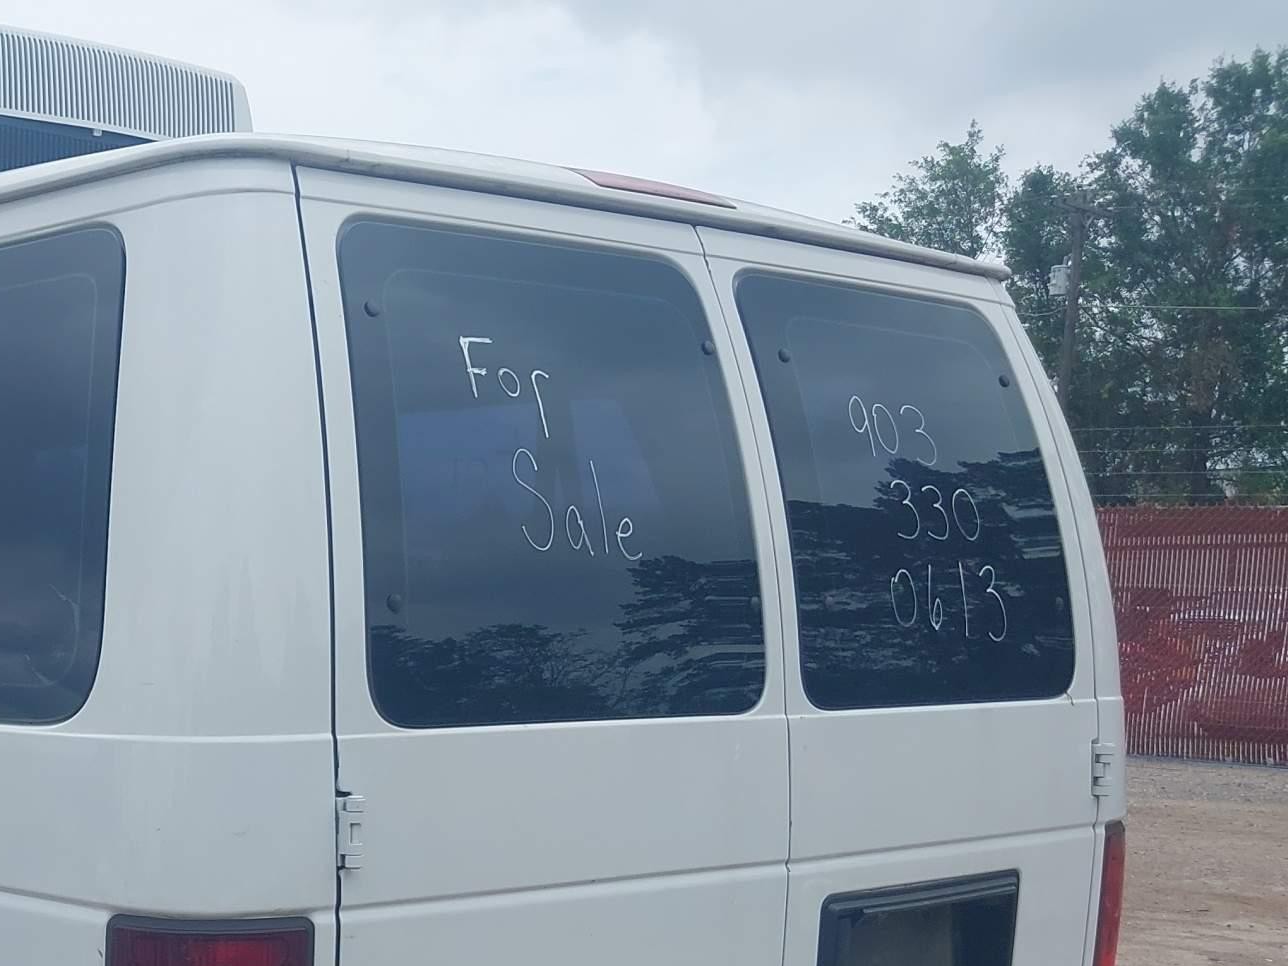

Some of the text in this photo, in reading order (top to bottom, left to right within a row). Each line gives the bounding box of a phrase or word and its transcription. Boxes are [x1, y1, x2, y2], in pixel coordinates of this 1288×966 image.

[459, 336, 550, 438] For
[849, 396, 937, 466] 903
[513, 448, 642, 560] Sale
[890, 480, 980, 541] 330
[890, 561, 1007, 642] 0613
